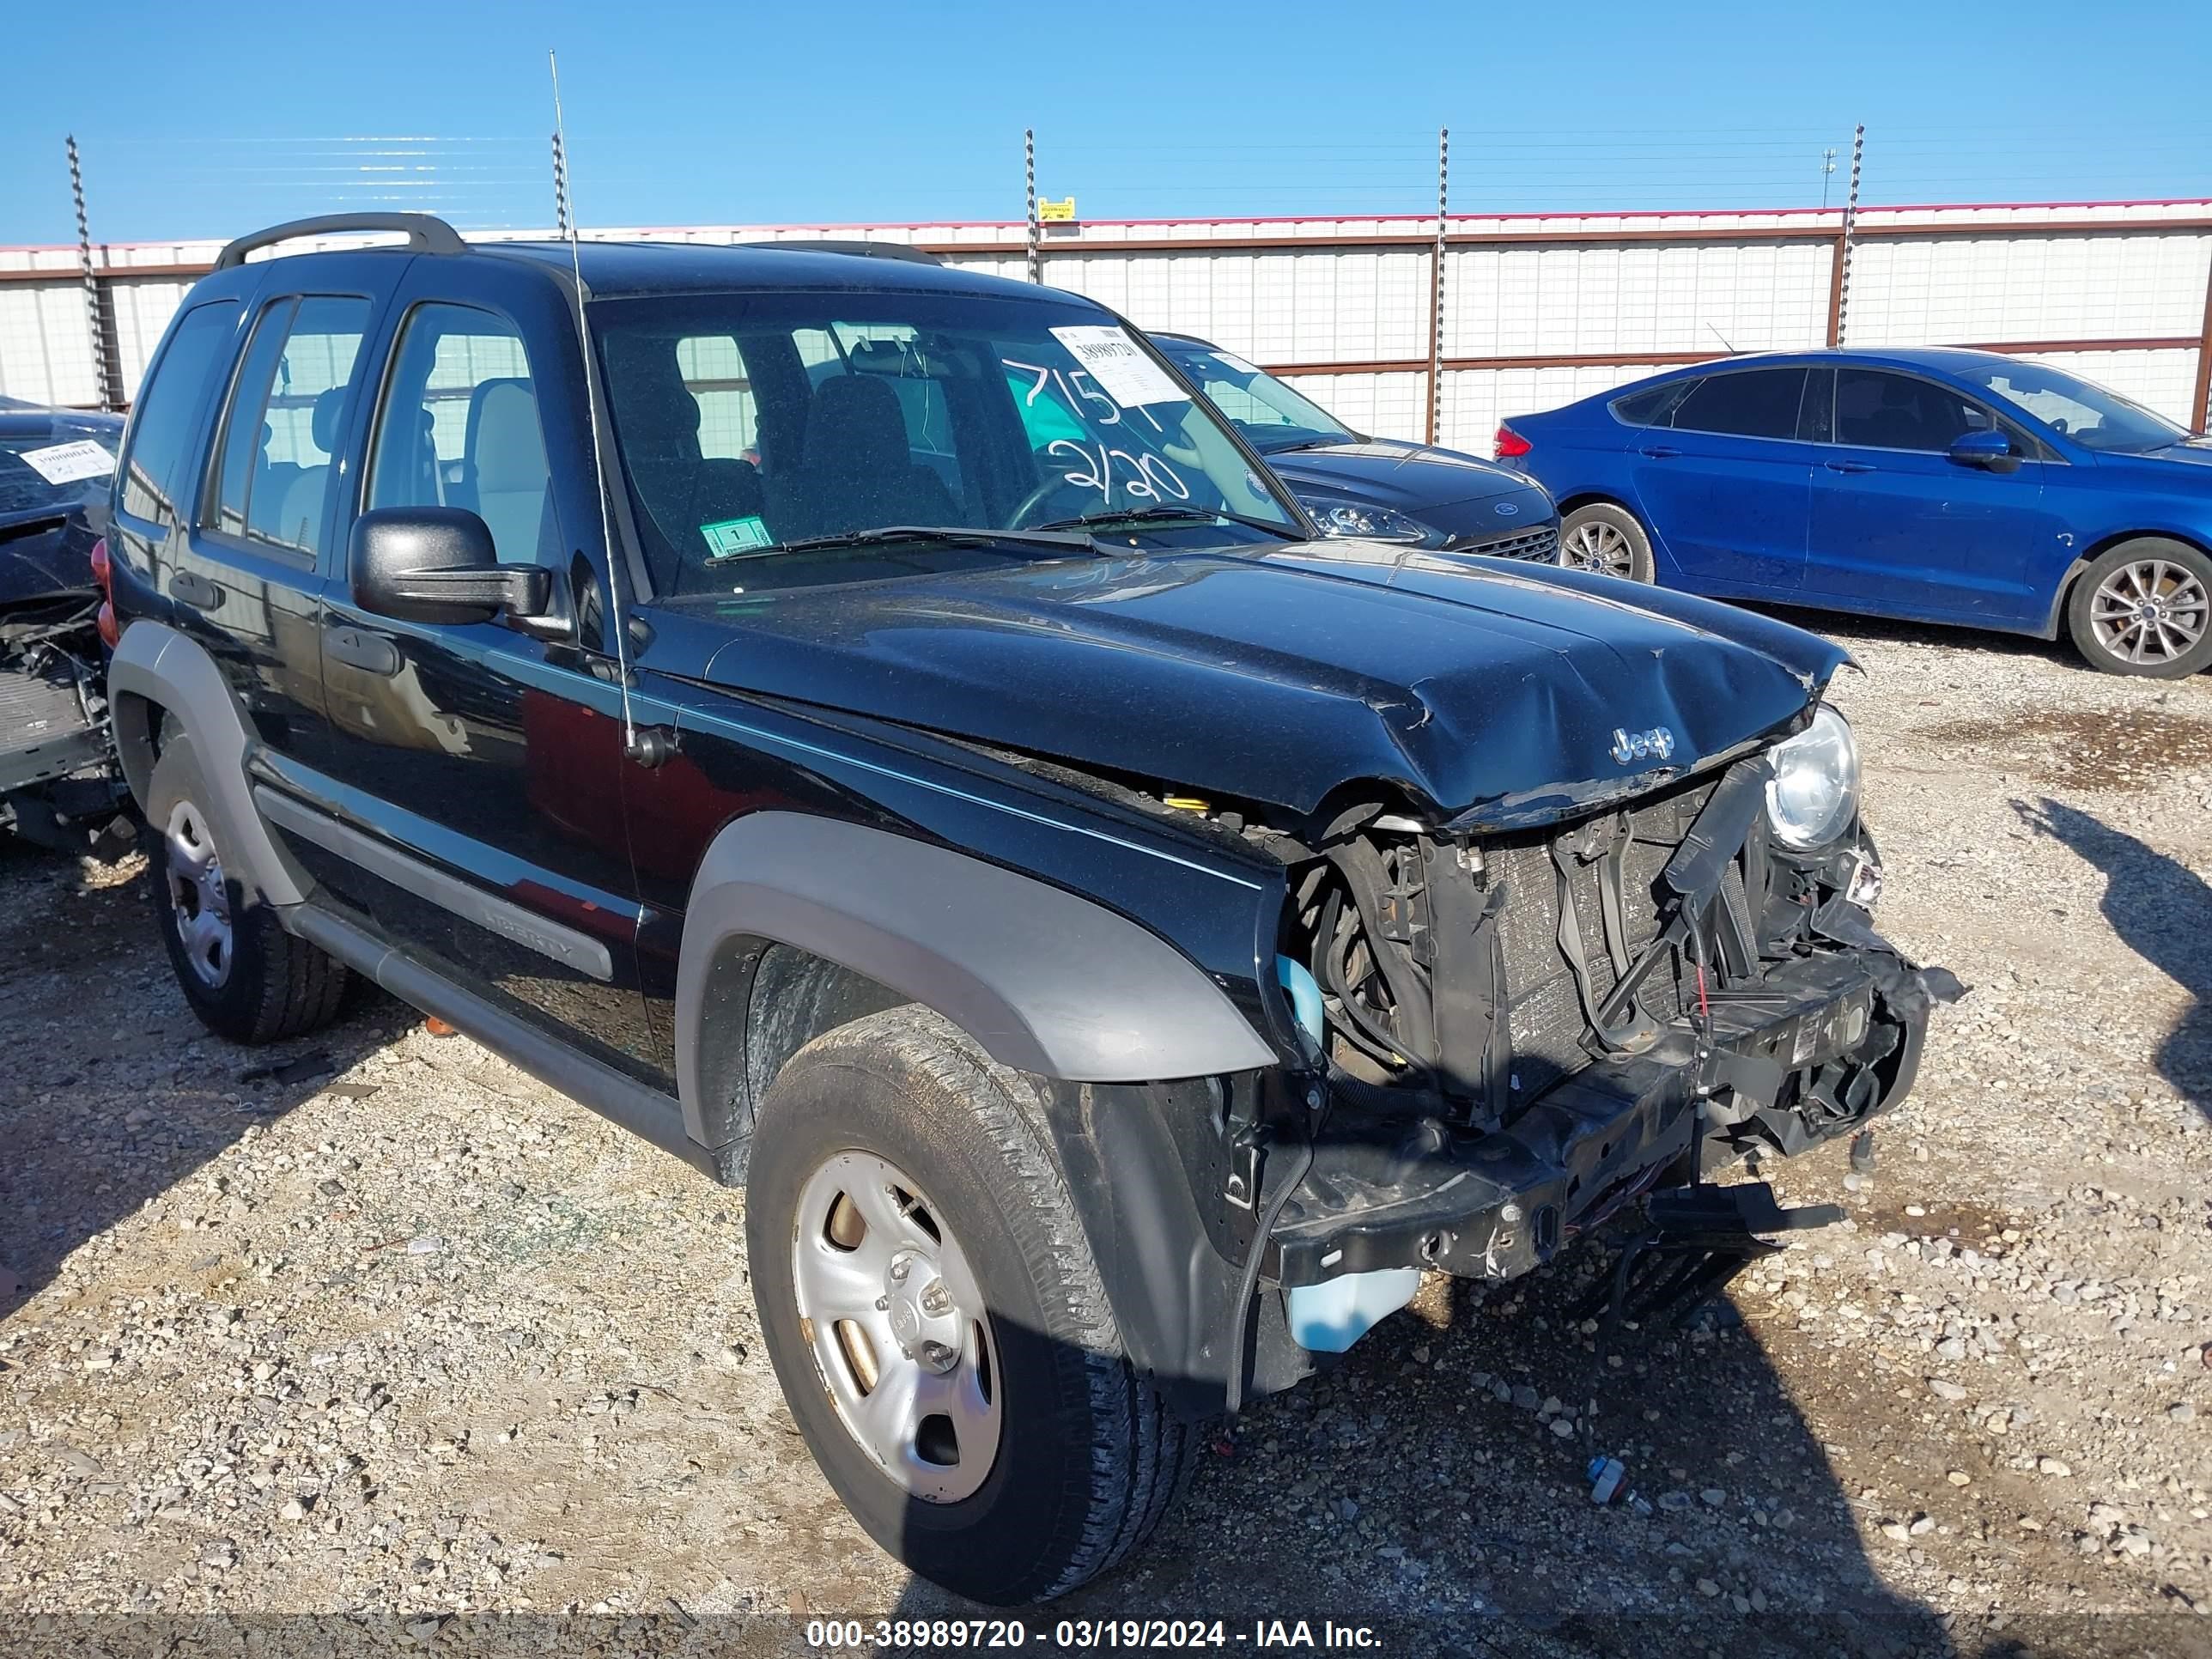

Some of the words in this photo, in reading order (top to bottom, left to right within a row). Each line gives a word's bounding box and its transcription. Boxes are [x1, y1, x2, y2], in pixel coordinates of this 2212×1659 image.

[1076, 343, 1138, 360] 38989720
[1048, 440, 1189, 505] 2/20
[730, 529, 740, 541] 1
[1608, 726, 1674, 766] Jeep
